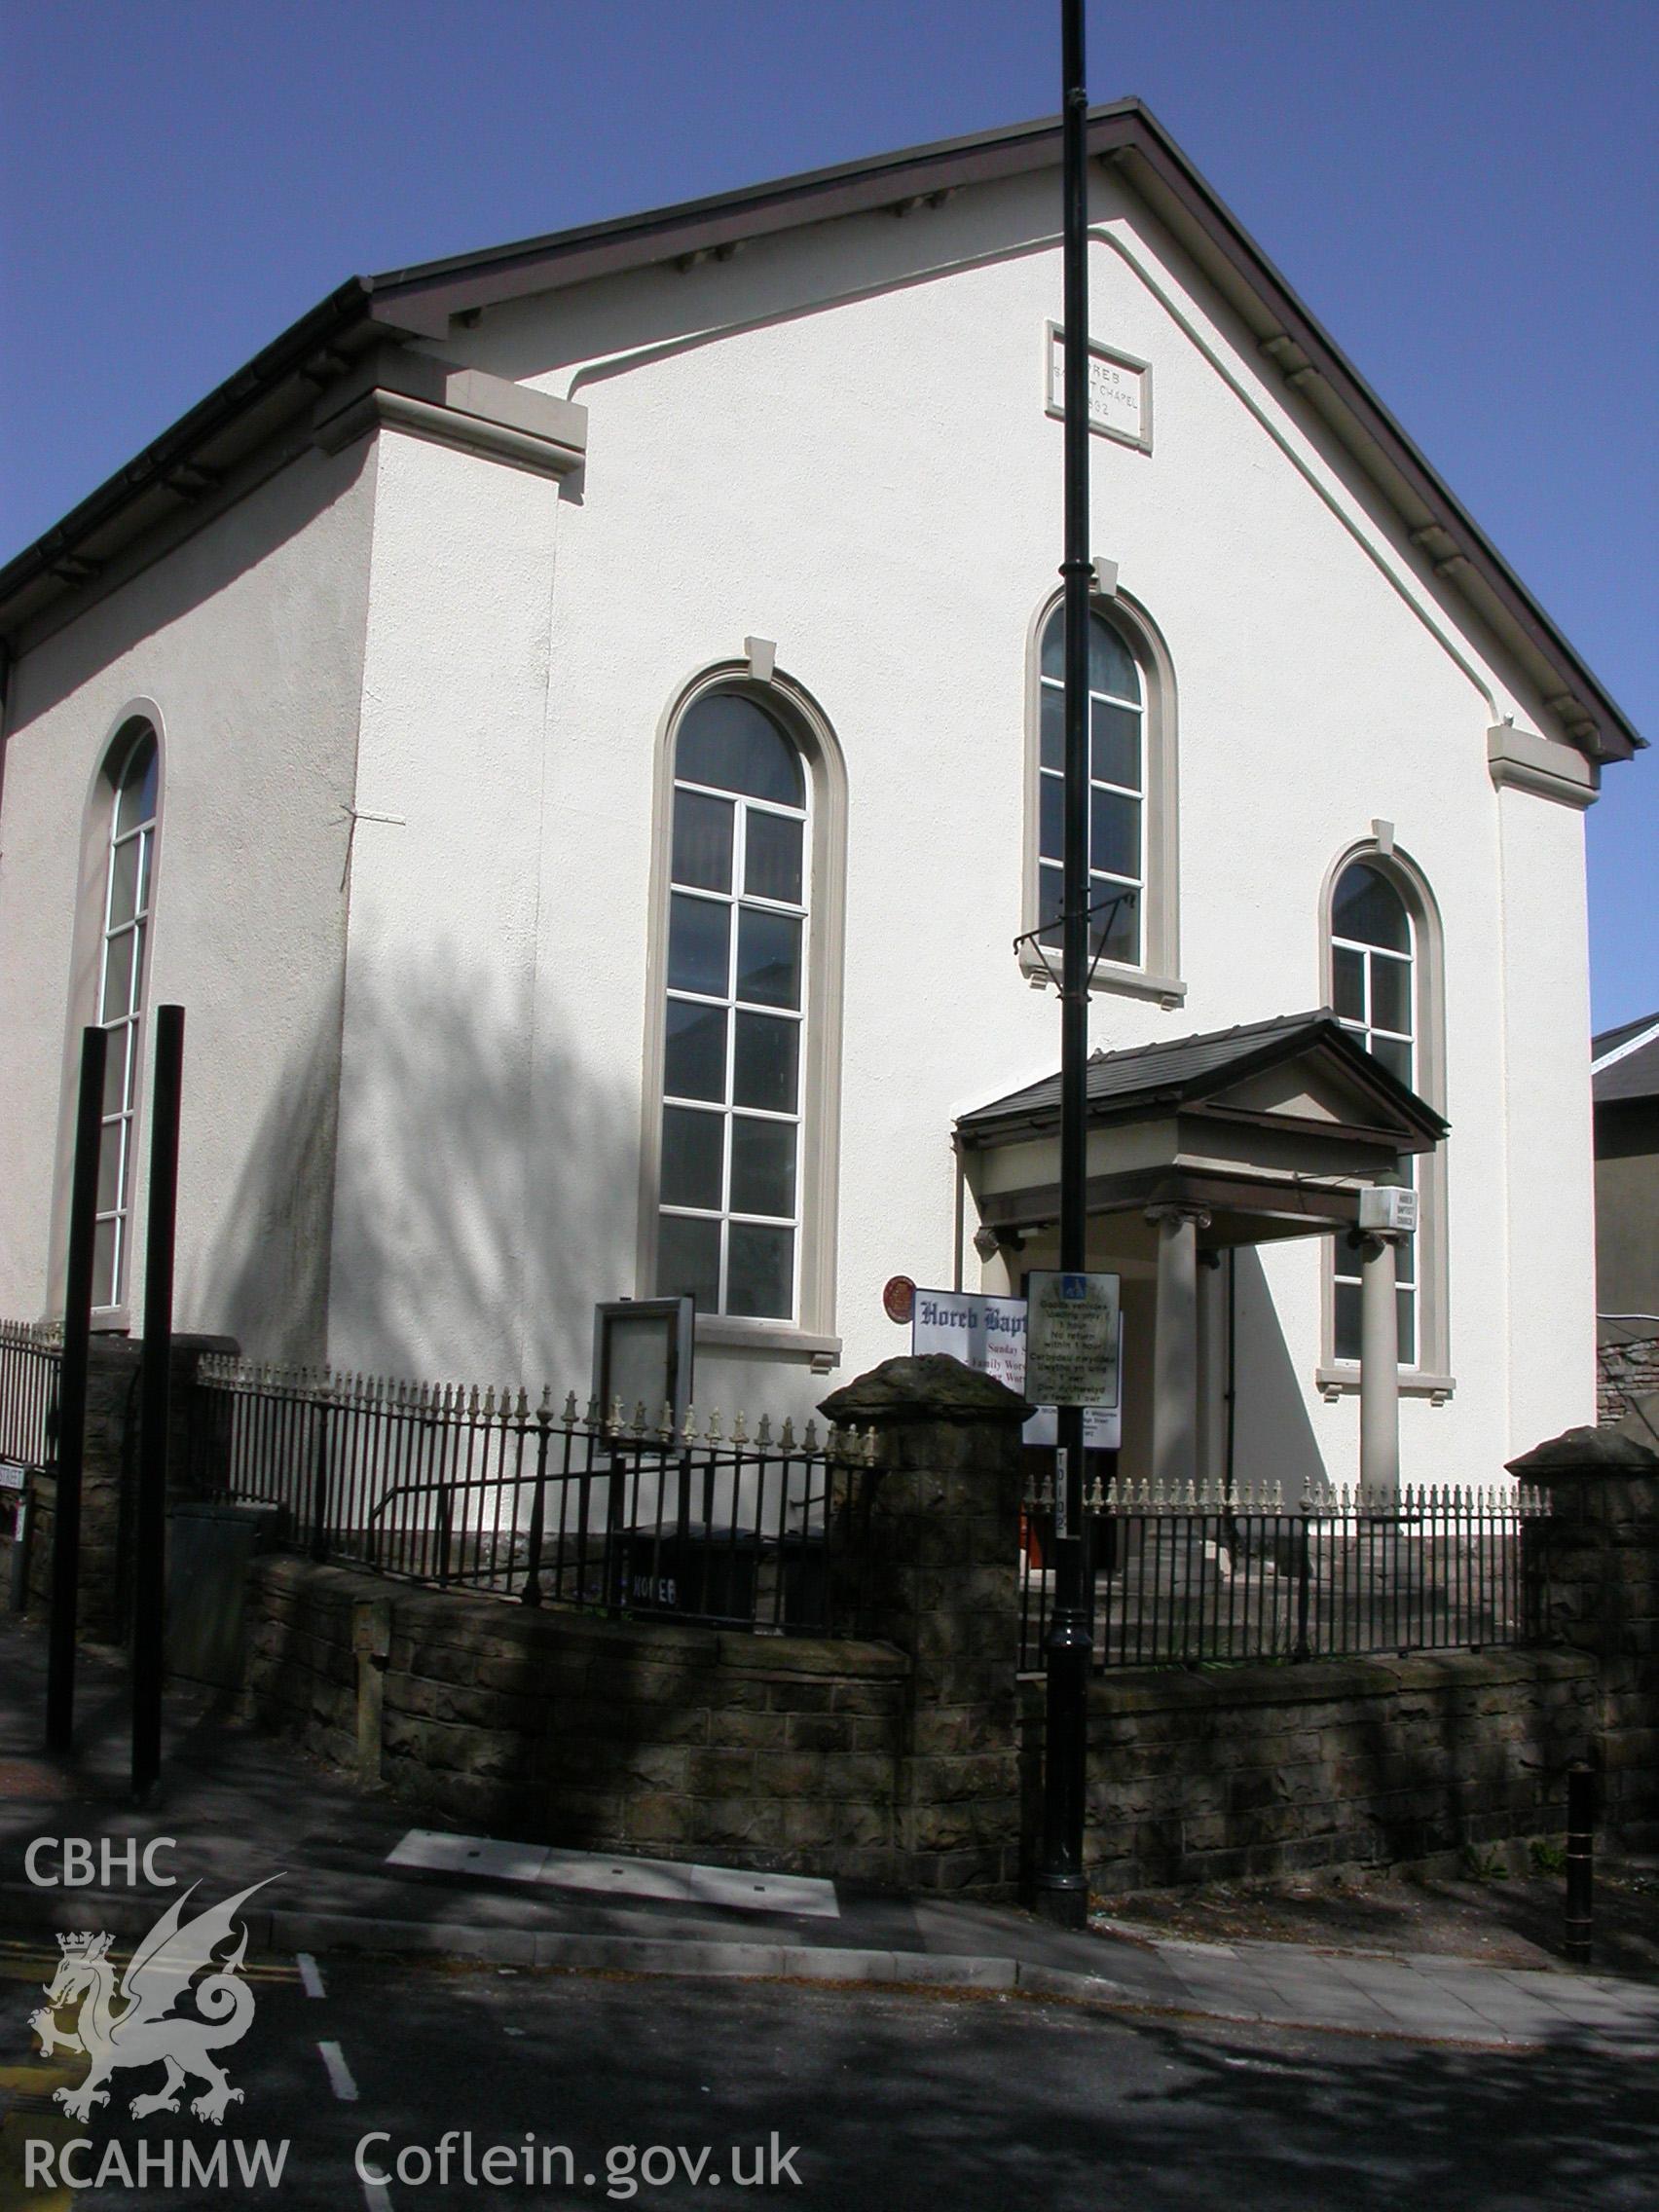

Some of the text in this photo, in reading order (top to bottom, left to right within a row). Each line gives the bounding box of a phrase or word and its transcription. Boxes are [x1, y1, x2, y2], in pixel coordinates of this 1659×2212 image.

[1100, 385, 1137, 409] CHAPEL
[920, 1301, 977, 1330] Horeb
[988, 1342, 1018, 1356] Sunday
